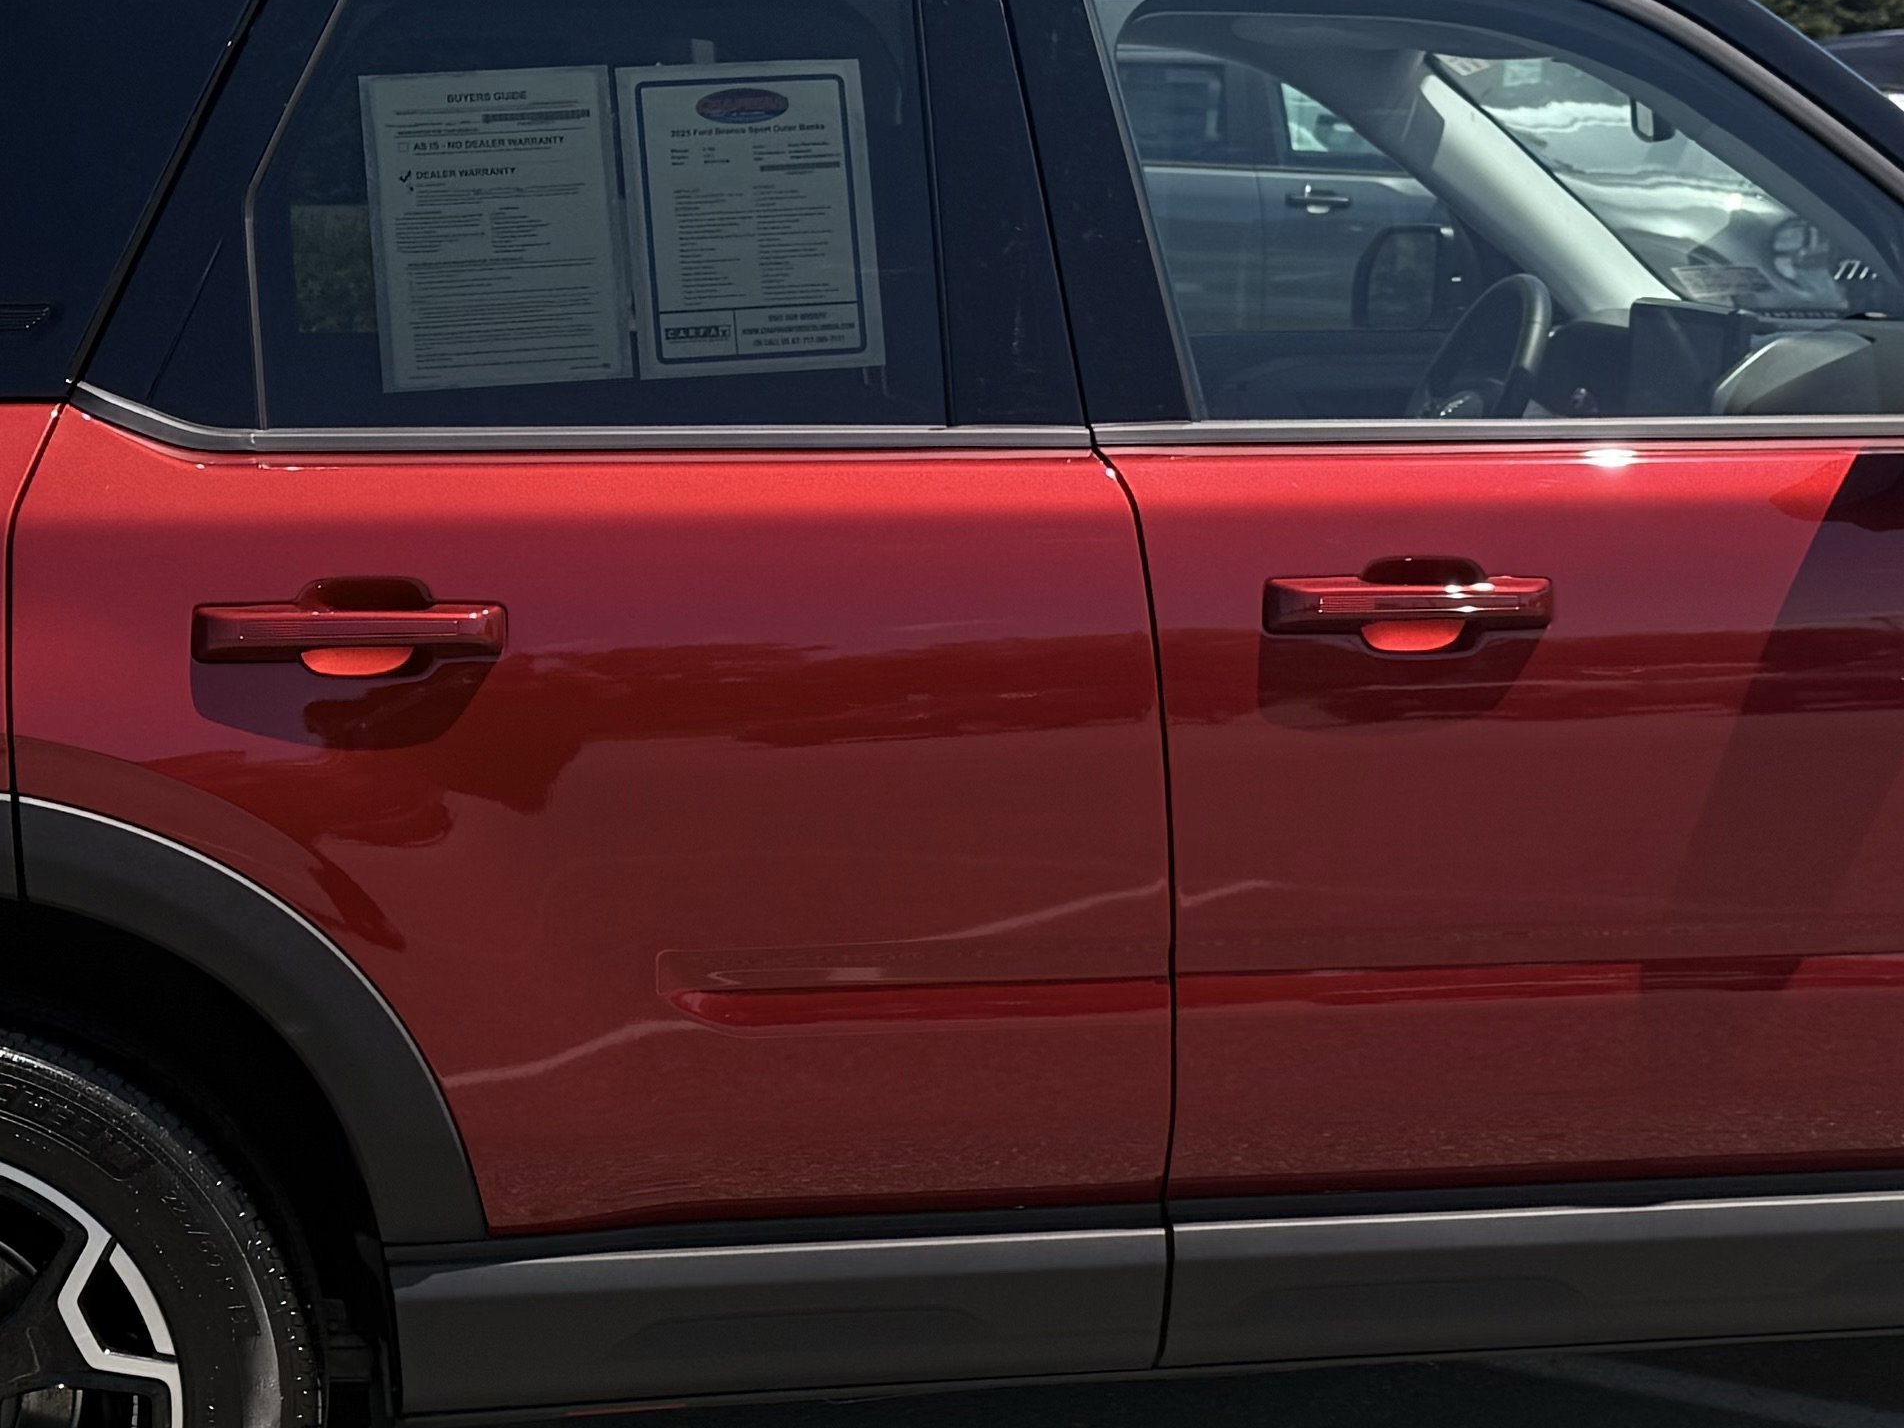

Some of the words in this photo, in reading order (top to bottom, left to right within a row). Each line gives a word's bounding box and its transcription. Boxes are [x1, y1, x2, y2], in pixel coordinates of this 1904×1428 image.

[447, 92, 491, 104] BUYERS
[493, 90, 527, 102] GUIDE
[413, 142, 428, 151] AS
[447, 141, 463, 150] NO
[464, 138, 505, 149] DEALER
[507, 135, 564, 147] WARRANTY
[415, 169, 457, 181] DEALER
[458, 167, 516, 179] WARRANTY
[665, 326, 731, 340] CARFAX
